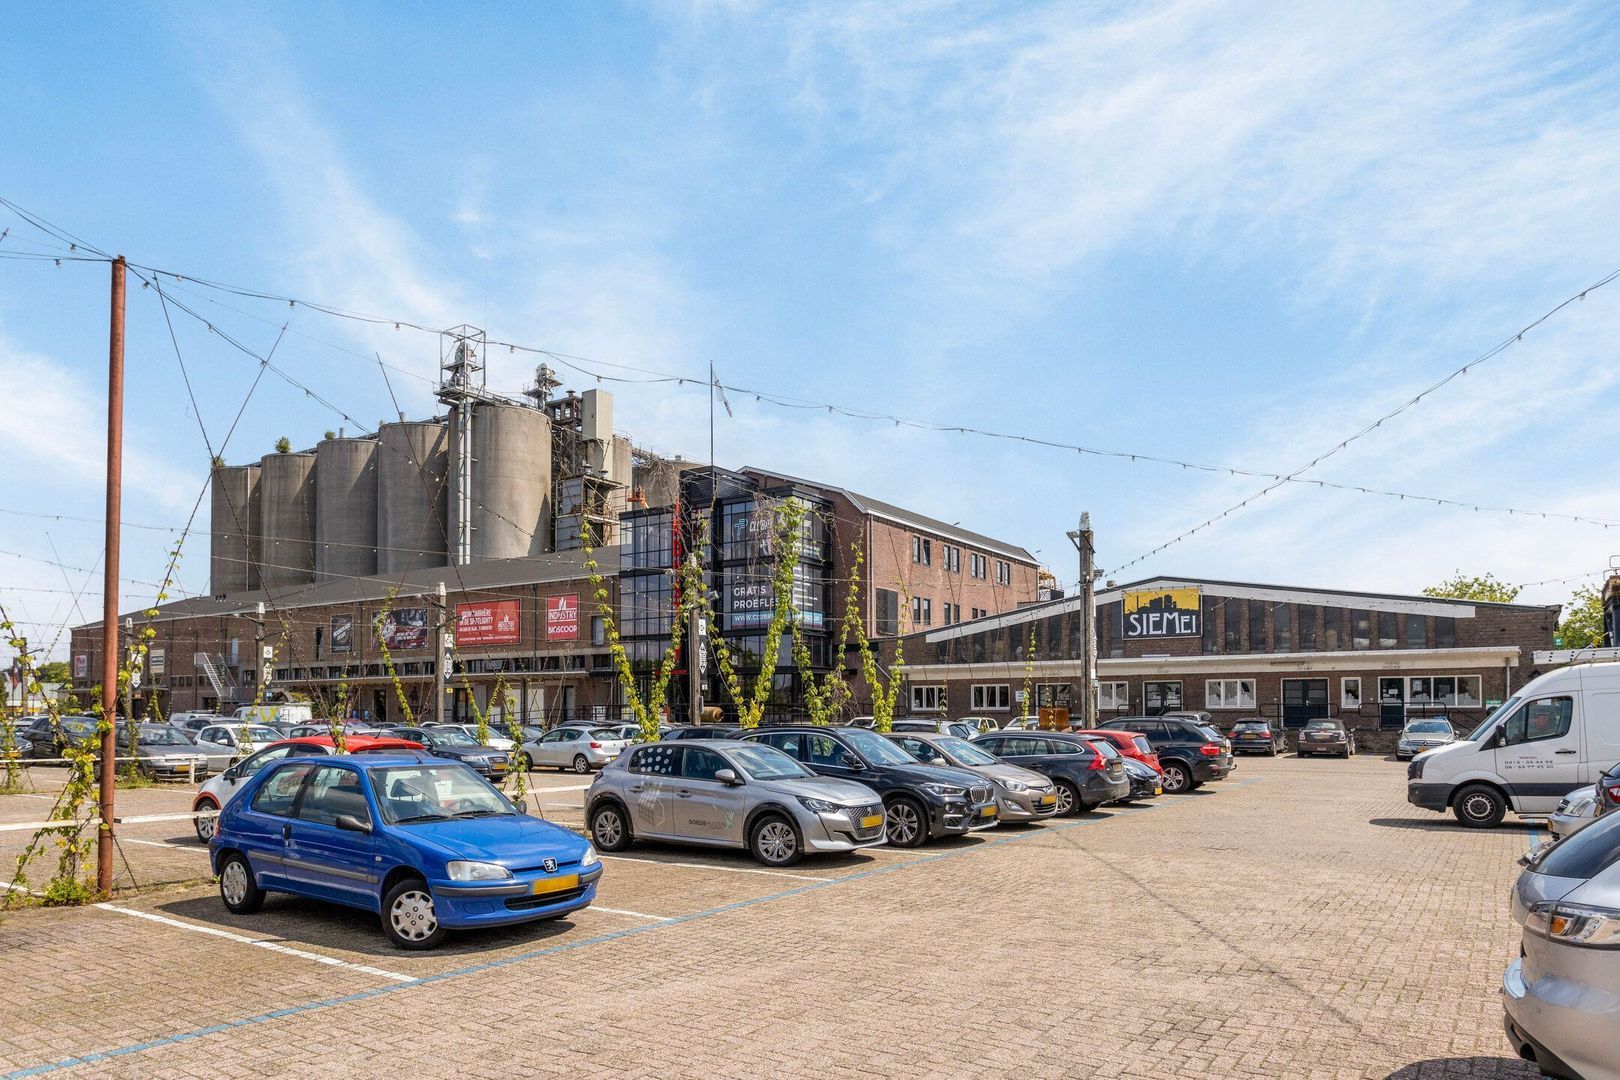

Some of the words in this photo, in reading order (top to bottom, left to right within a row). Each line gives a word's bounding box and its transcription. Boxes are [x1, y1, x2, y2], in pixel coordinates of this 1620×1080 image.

[733, 585, 766, 597] GRATIS
[733, 597, 780, 610] PROEFLES
[548, 611, 577, 620] INDUSTRY
[548, 625, 577, 633] BIOSCOOP
[1127, 611, 1197, 637] SIEMEI
